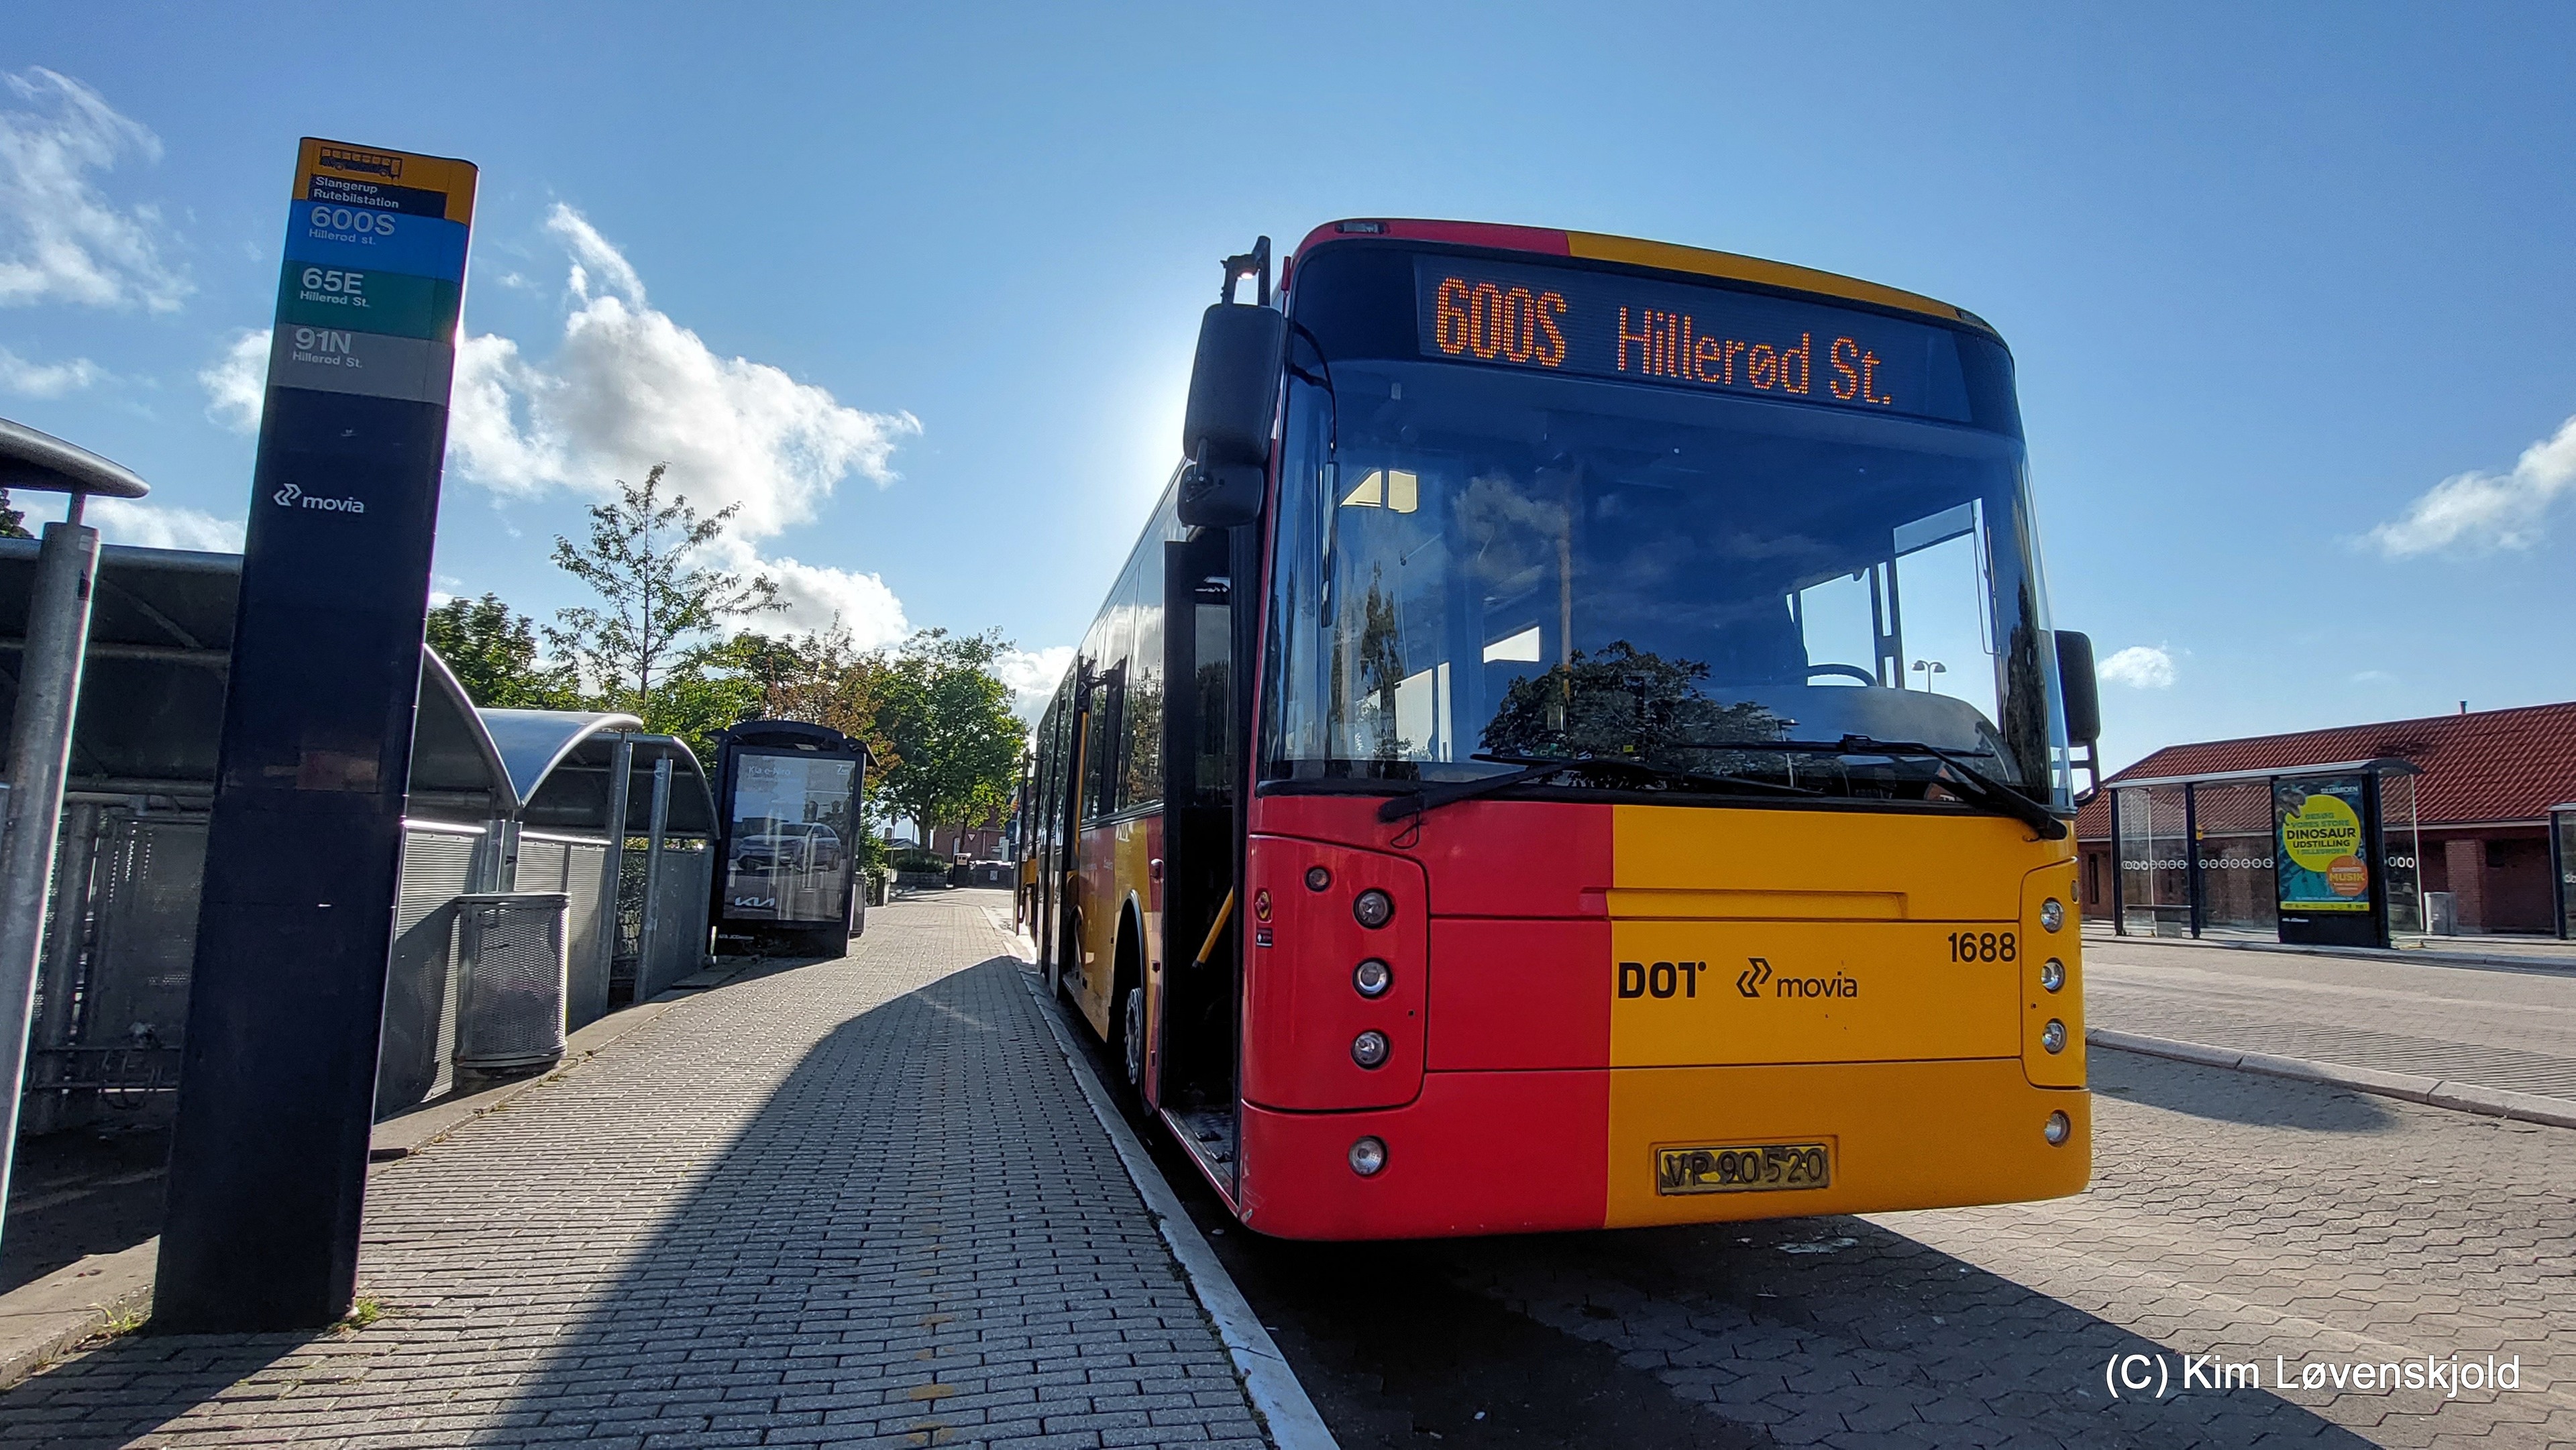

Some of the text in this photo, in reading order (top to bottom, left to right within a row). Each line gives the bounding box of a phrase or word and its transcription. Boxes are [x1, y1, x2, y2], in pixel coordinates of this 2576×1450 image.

[315, 176, 378, 194] Slangerup
[313, 188, 399, 209] Rutebilstation
[311, 206, 396, 235] 600S
[303, 268, 364, 295] 65E
[295, 328, 352, 354] 91N
[1436, 277, 1892, 405] 600S Hillerød St.
[303, 496, 364, 513] movia
[2286, 828, 2356, 840] DINOSAUR
[2293, 840, 2350, 848] UDSTILLING
[2329, 873, 2365, 881] MUSIK
[1948, 932, 2017, 962] 1688
[1617, 961, 1701, 999] DOT
[1776, 970, 1858, 998] movia
